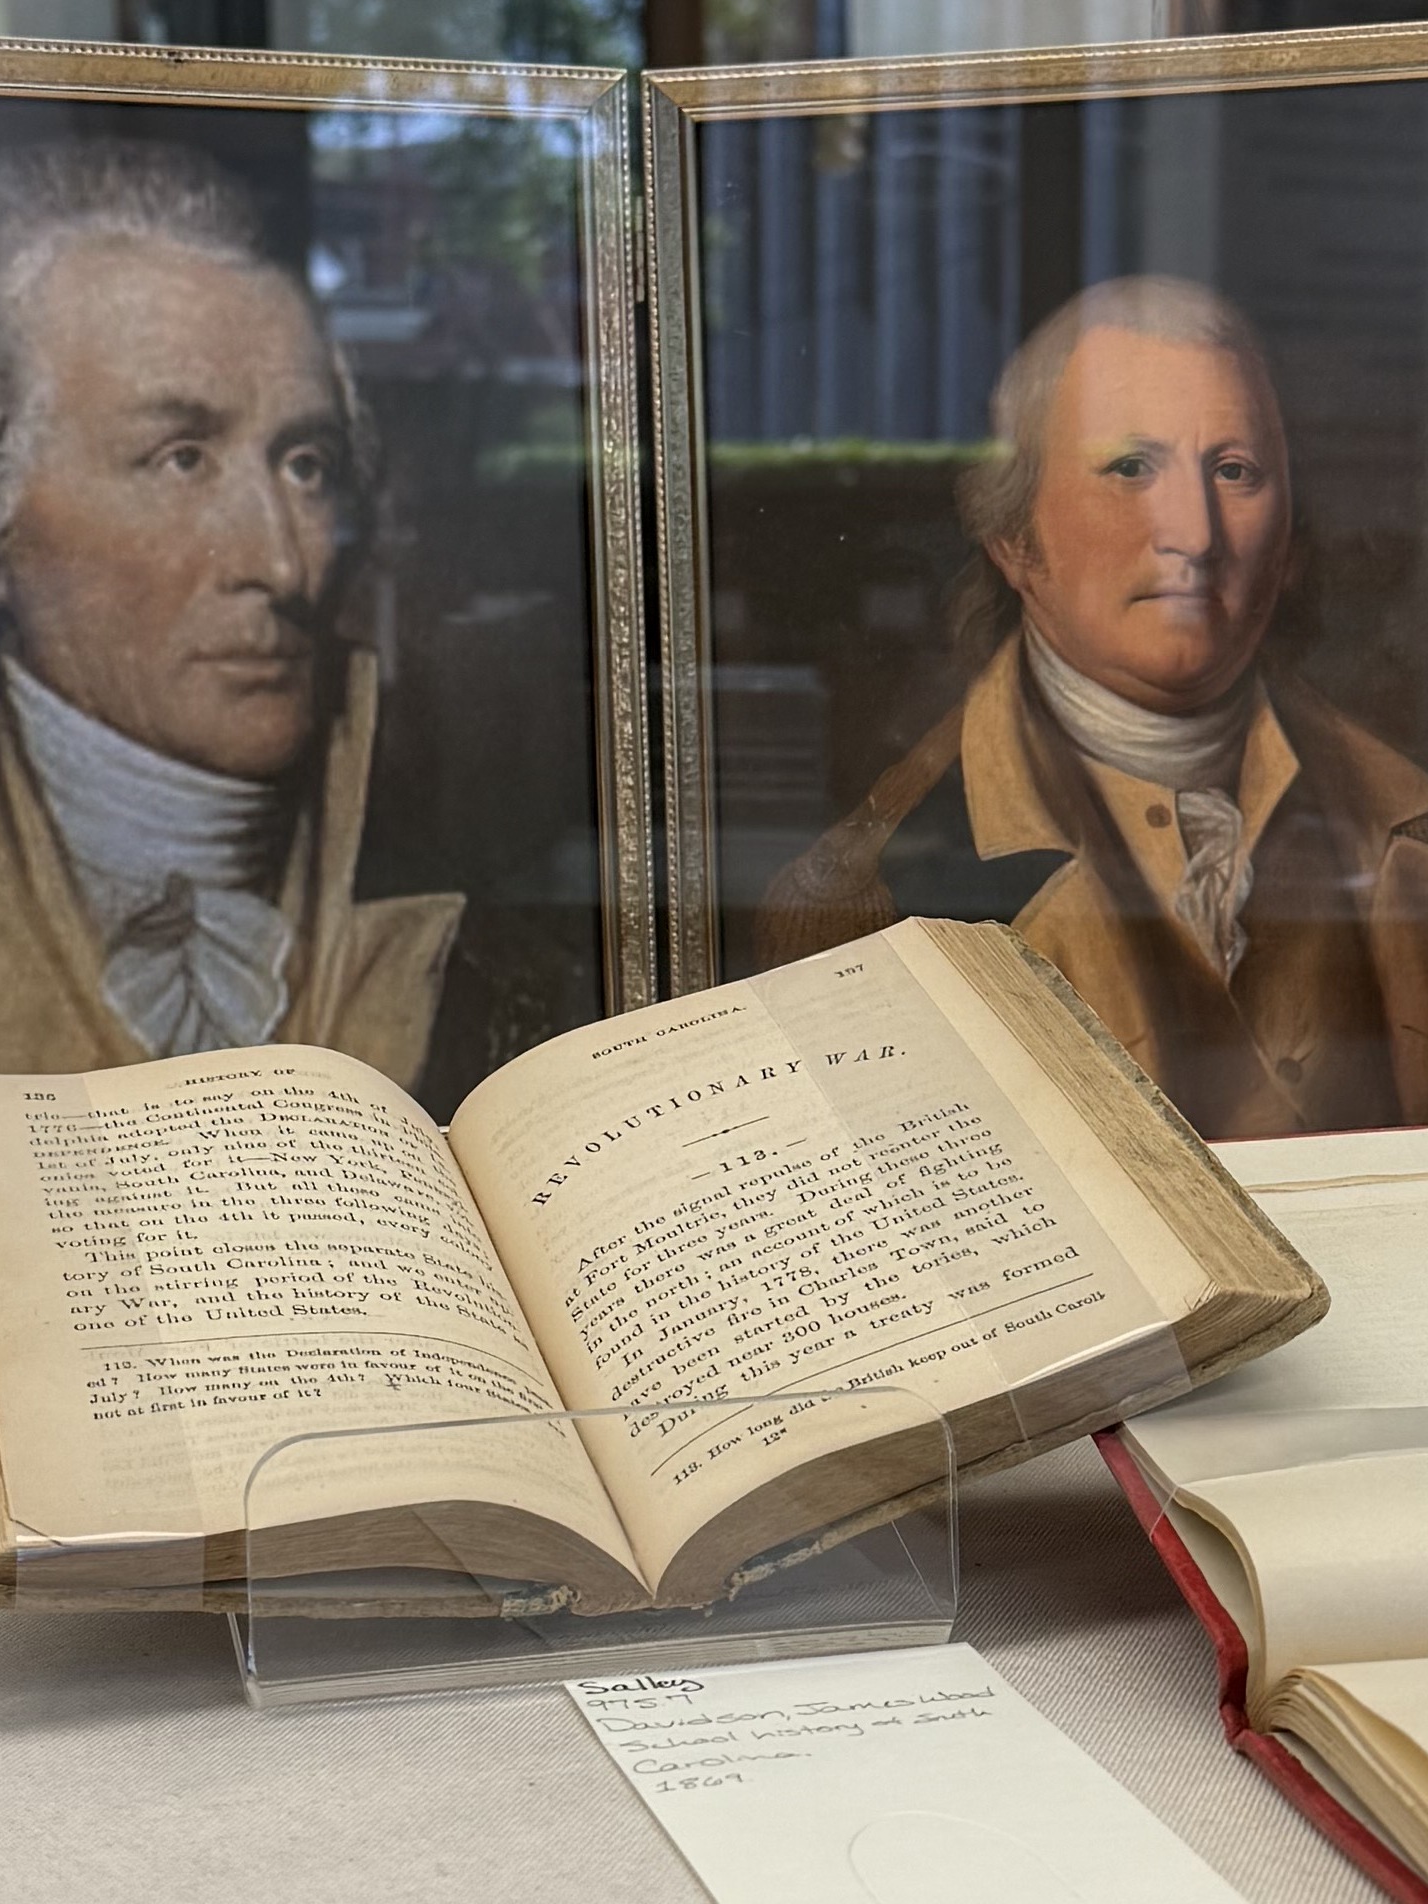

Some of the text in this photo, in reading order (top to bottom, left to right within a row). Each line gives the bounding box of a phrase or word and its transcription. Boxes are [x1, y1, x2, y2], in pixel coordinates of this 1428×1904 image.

[531, 1045, 907, 1207] REVOLUTIONARY WAR.
[592, 1035, 647, 1060] SOUTH
[576, 1104, 970, 1273] After the signal repulse of the British
[595, 1174, 1024, 1370] found in the history of the United States.
